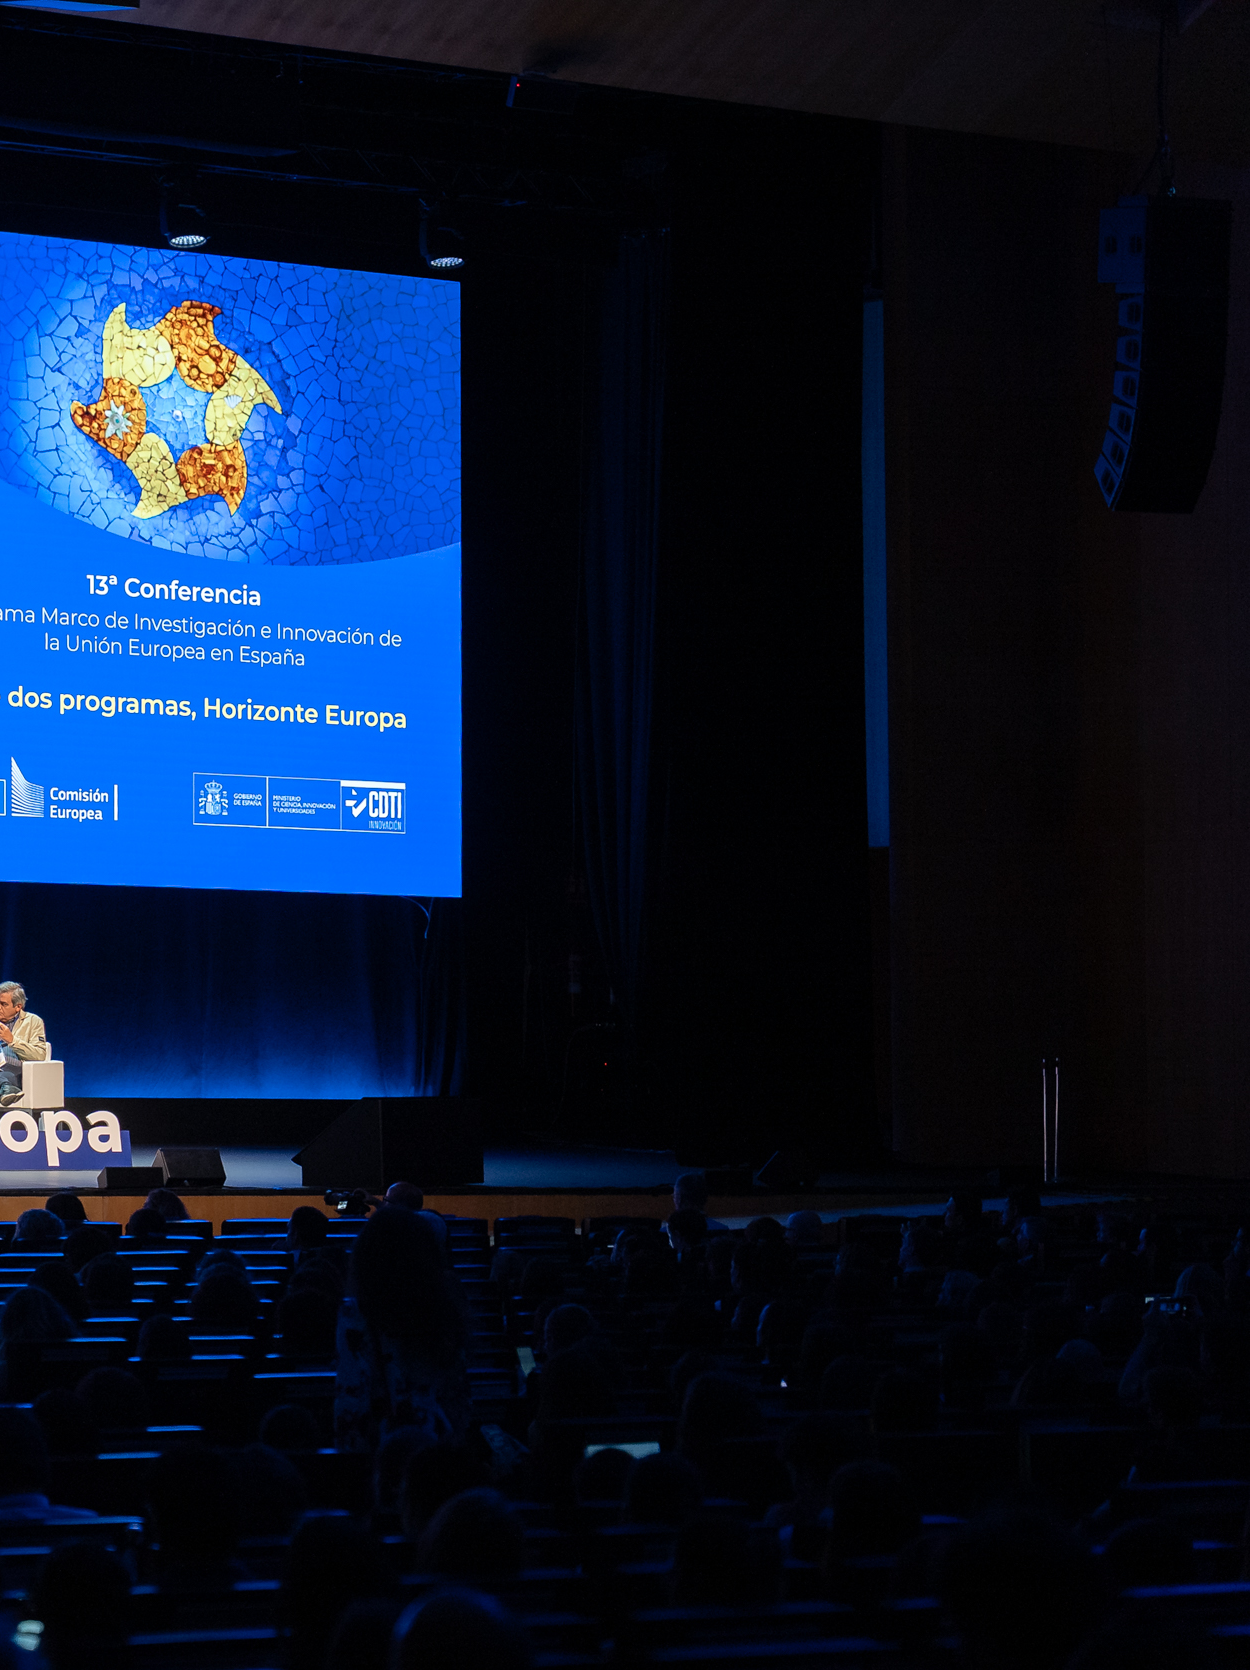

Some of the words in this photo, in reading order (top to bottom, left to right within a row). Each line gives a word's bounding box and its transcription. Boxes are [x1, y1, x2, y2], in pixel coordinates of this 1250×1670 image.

[86, 574, 118, 595] 13ª
[124, 577, 261, 606] Conferencia
[42, 606, 100, 627] Marco
[104, 611, 129, 629] de
[134, 613, 256, 638] Investigación
[260, 626, 272, 639] e
[277, 623, 374, 646] Innovación
[379, 630, 402, 647] de
[44, 632, 60, 651] la
[66, 634, 122, 655] Unión
[129, 638, 205, 662] Europea
[210, 648, 233, 662] en
[239, 646, 305, 667] España
[7, 685, 52, 709] dos
[59, 693, 197, 721] programas,
[204, 697, 318, 724] Horizonte
[325, 704, 407, 733] Europa
[49, 787, 109, 803] Comisión
[233, 792, 263, 800] GOBIERNO
[273, 794, 301, 802] MINISTERIO
[368, 790, 402, 819] CDTI
[49, 805, 103, 823] Europea
